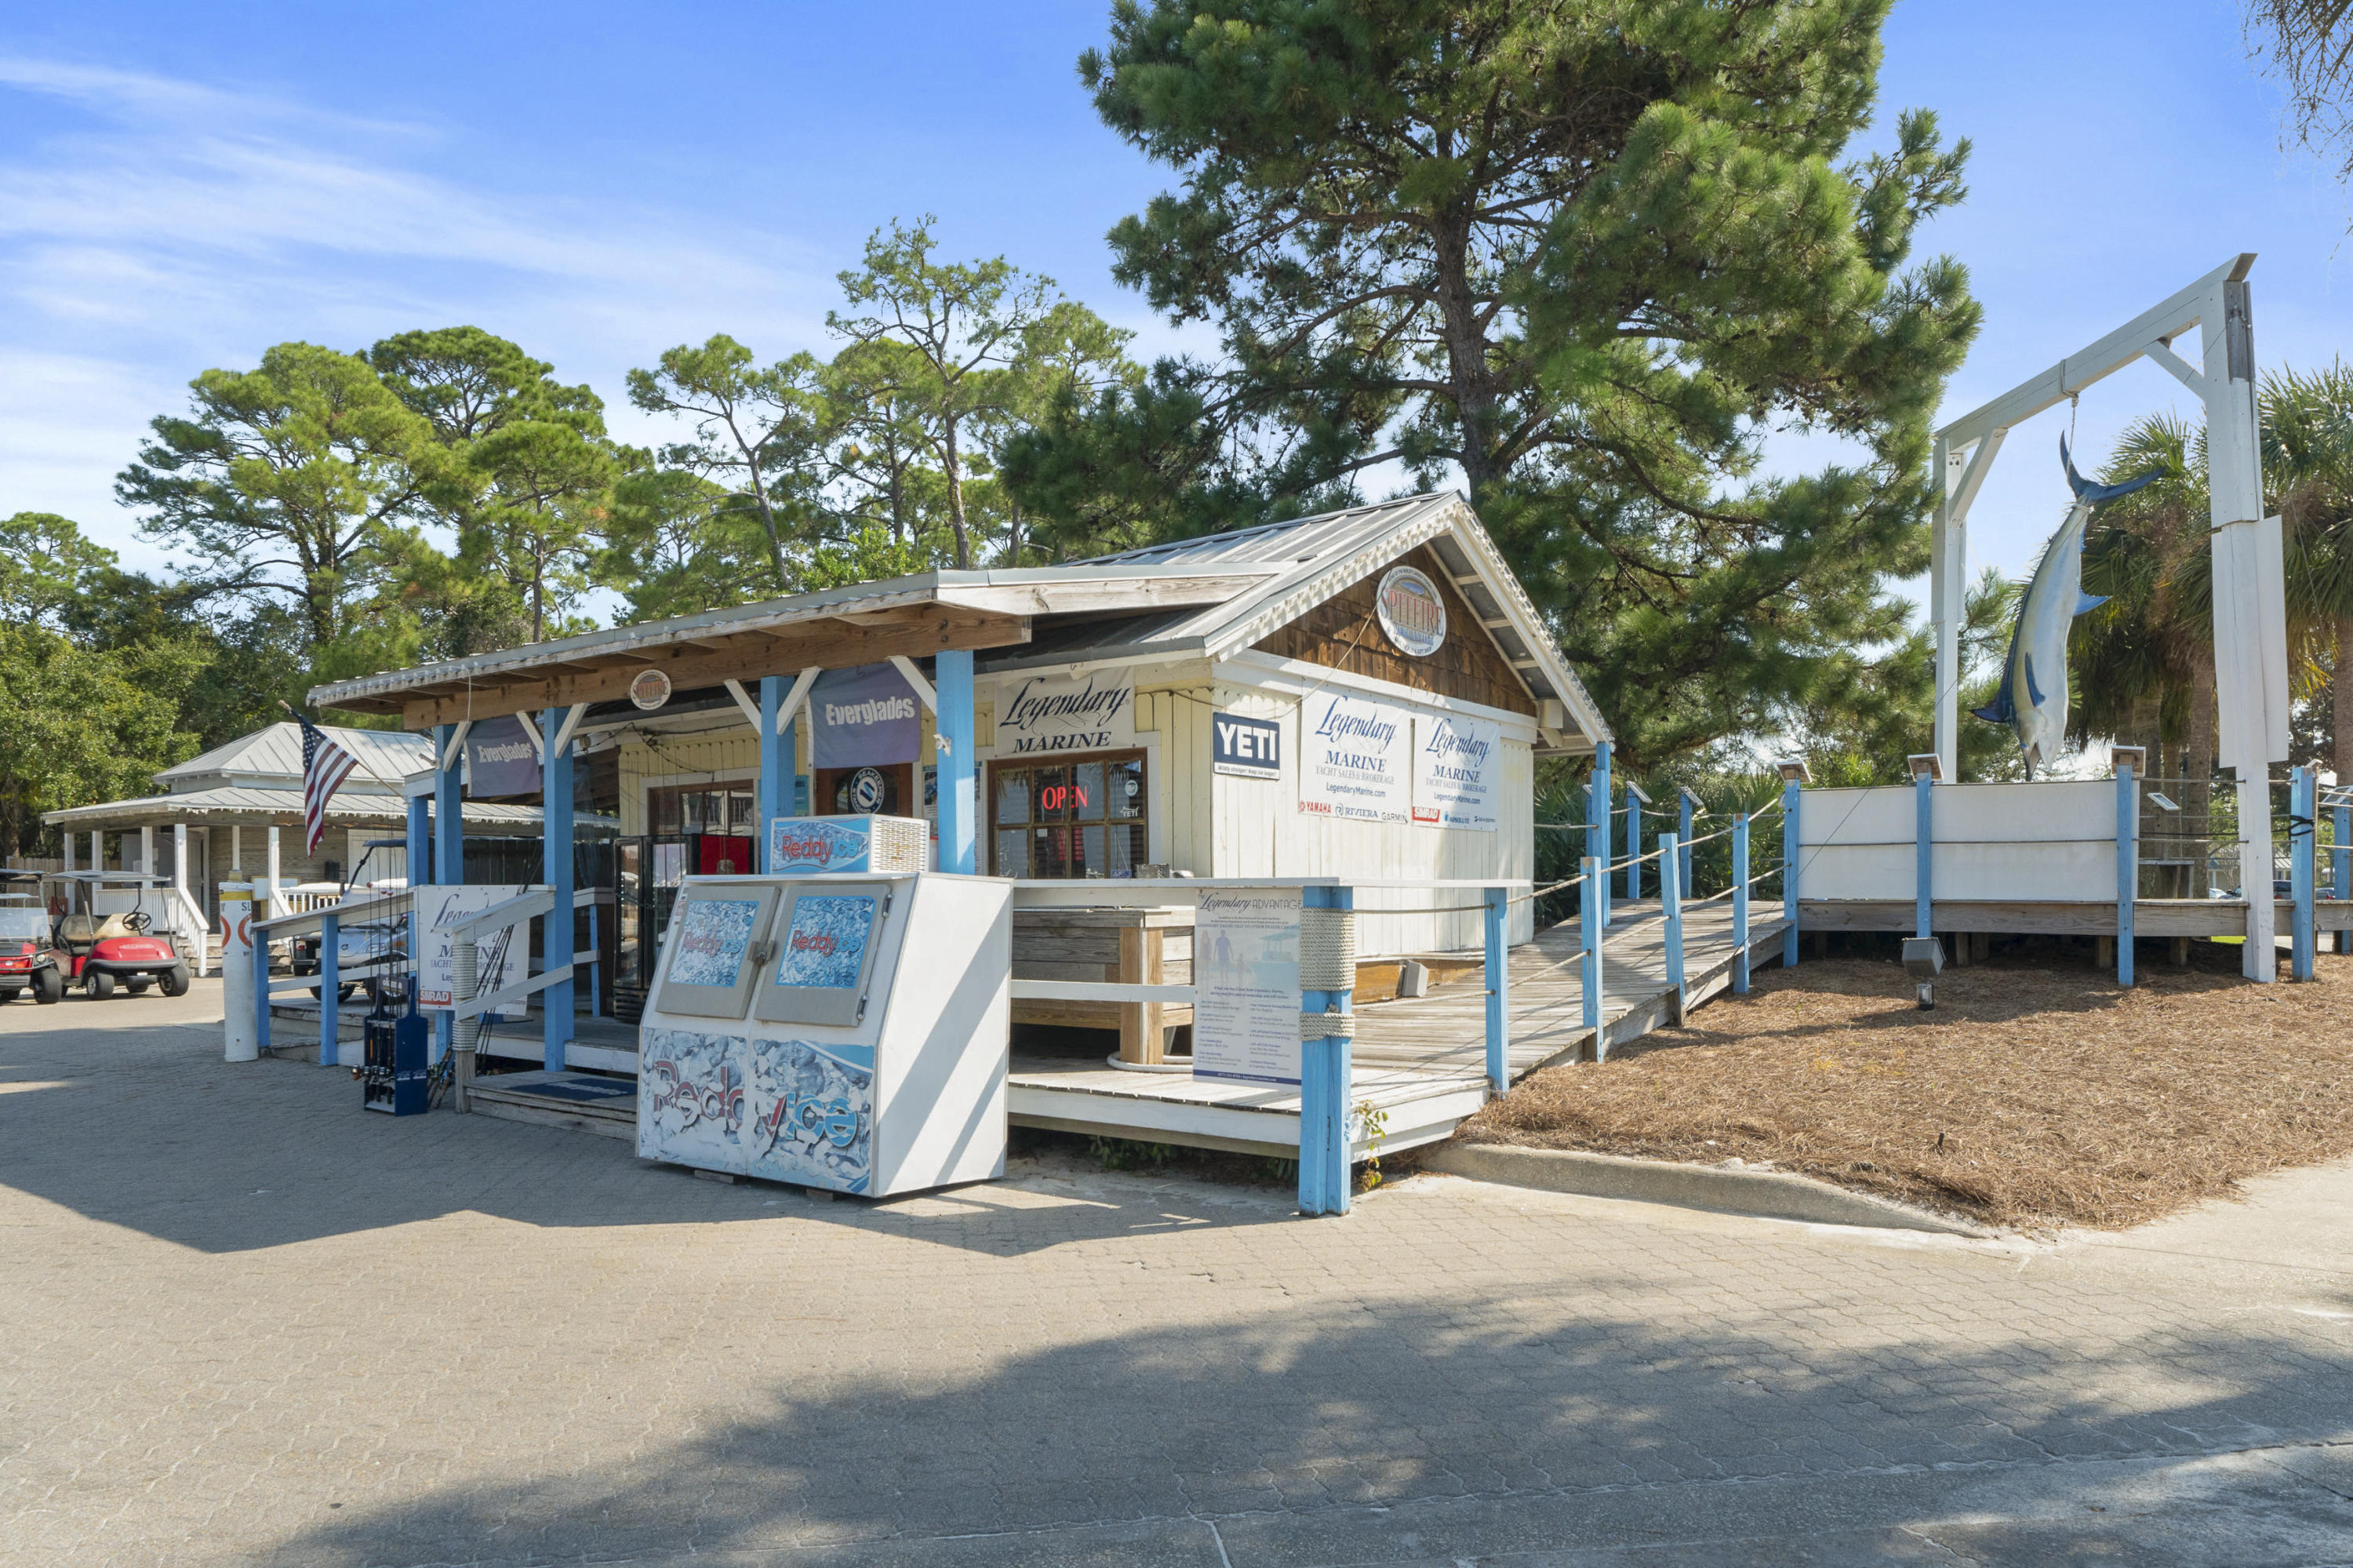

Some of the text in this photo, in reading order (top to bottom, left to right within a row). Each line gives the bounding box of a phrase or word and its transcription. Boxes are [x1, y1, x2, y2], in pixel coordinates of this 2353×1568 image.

[1380, 588, 1443, 636] SPITFIRE
[825, 696, 915, 726] Everglades
[999, 676, 1130, 730] Legendary
[1315, 695, 1397, 754] Legendary
[477, 741, 533, 763] Everglades
[1011, 731, 1111, 753] MARINE
[1217, 721, 1278, 761] YETI
[1425, 718, 1489, 768] Legendary
[1325, 750, 1387, 773] MARINE
[1315, 765, 1337, 777] YACHT
[1338, 769, 1355, 780] SALES
[1361, 772, 1395, 784] BROKERAGE
[1432, 765, 1482, 784] MARINE
[858, 769, 882, 804] SEAKEEPER
[1042, 785, 1088, 809] OPEN
[1326, 781, 1386, 798] LegendaryMarine.com
[1307, 801, 1332, 813] YAMAHA
[1345, 807, 1379, 818] RIVIERA
[1381, 812, 1408, 823] GARMIN
[1414, 807, 1438, 819] SIMRAD
[781, 834, 833, 864] Reddy
[1199, 892, 1252, 914] Legendary
[1252, 899, 1302, 910] ADVANTAGE
[438, 944, 502, 960] MINE
[681, 931, 724, 958] Reddy
[791, 930, 839, 957] Reddy
[420, 990, 449, 1002] SIMRAD
